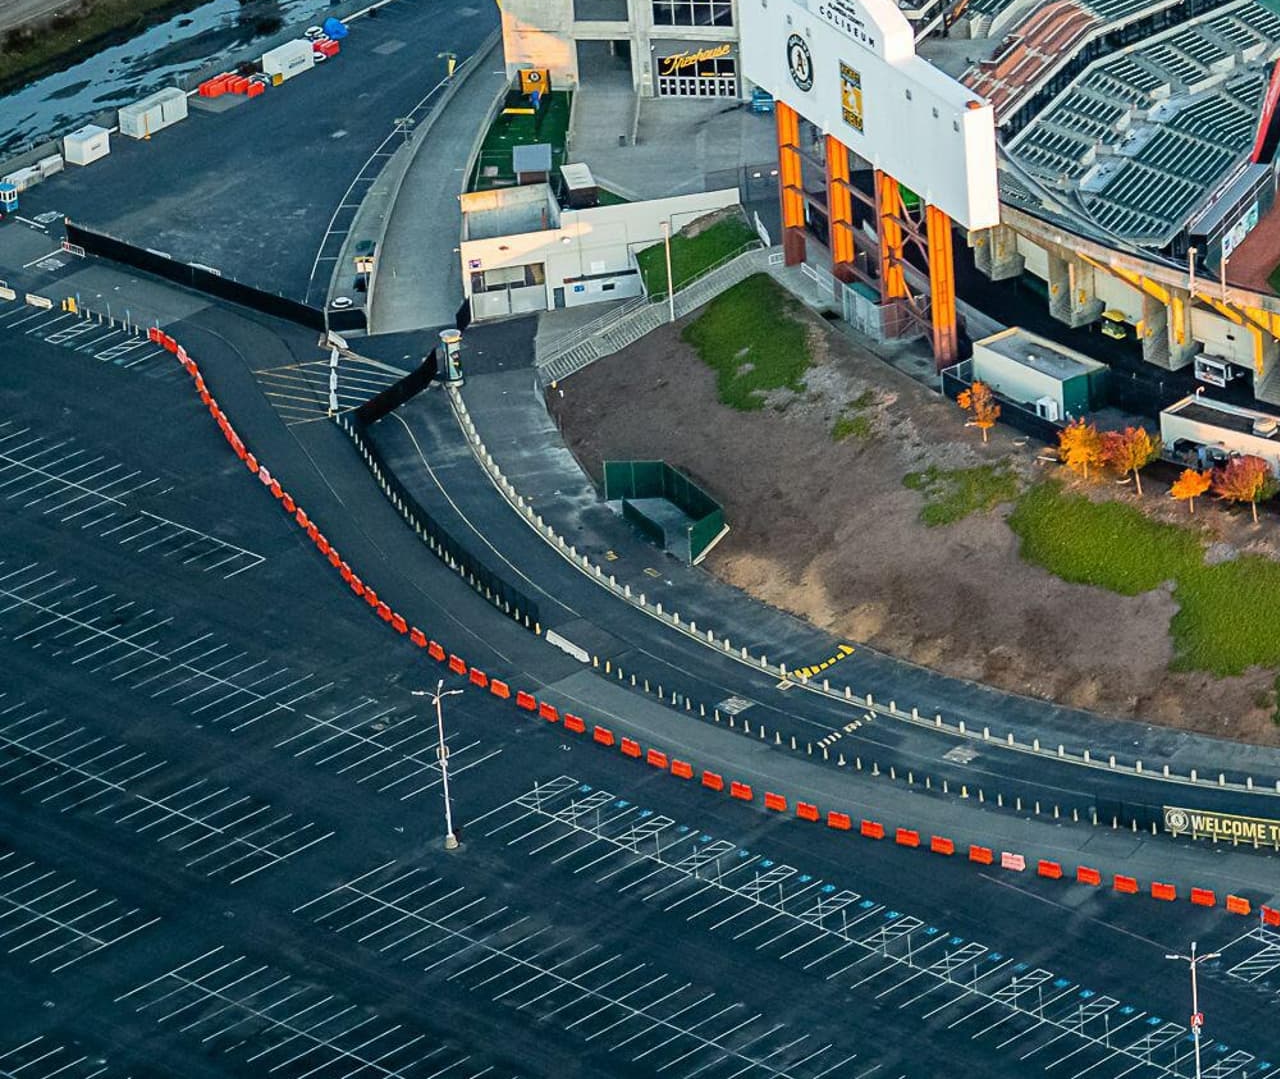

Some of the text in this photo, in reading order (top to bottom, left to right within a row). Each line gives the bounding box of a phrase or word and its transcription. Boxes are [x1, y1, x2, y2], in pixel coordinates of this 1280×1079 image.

[819, 6, 875, 49] COLISEUM
[661, 44, 731, 75] Treehouse
[1190, 815, 1266, 840] WELCOME
